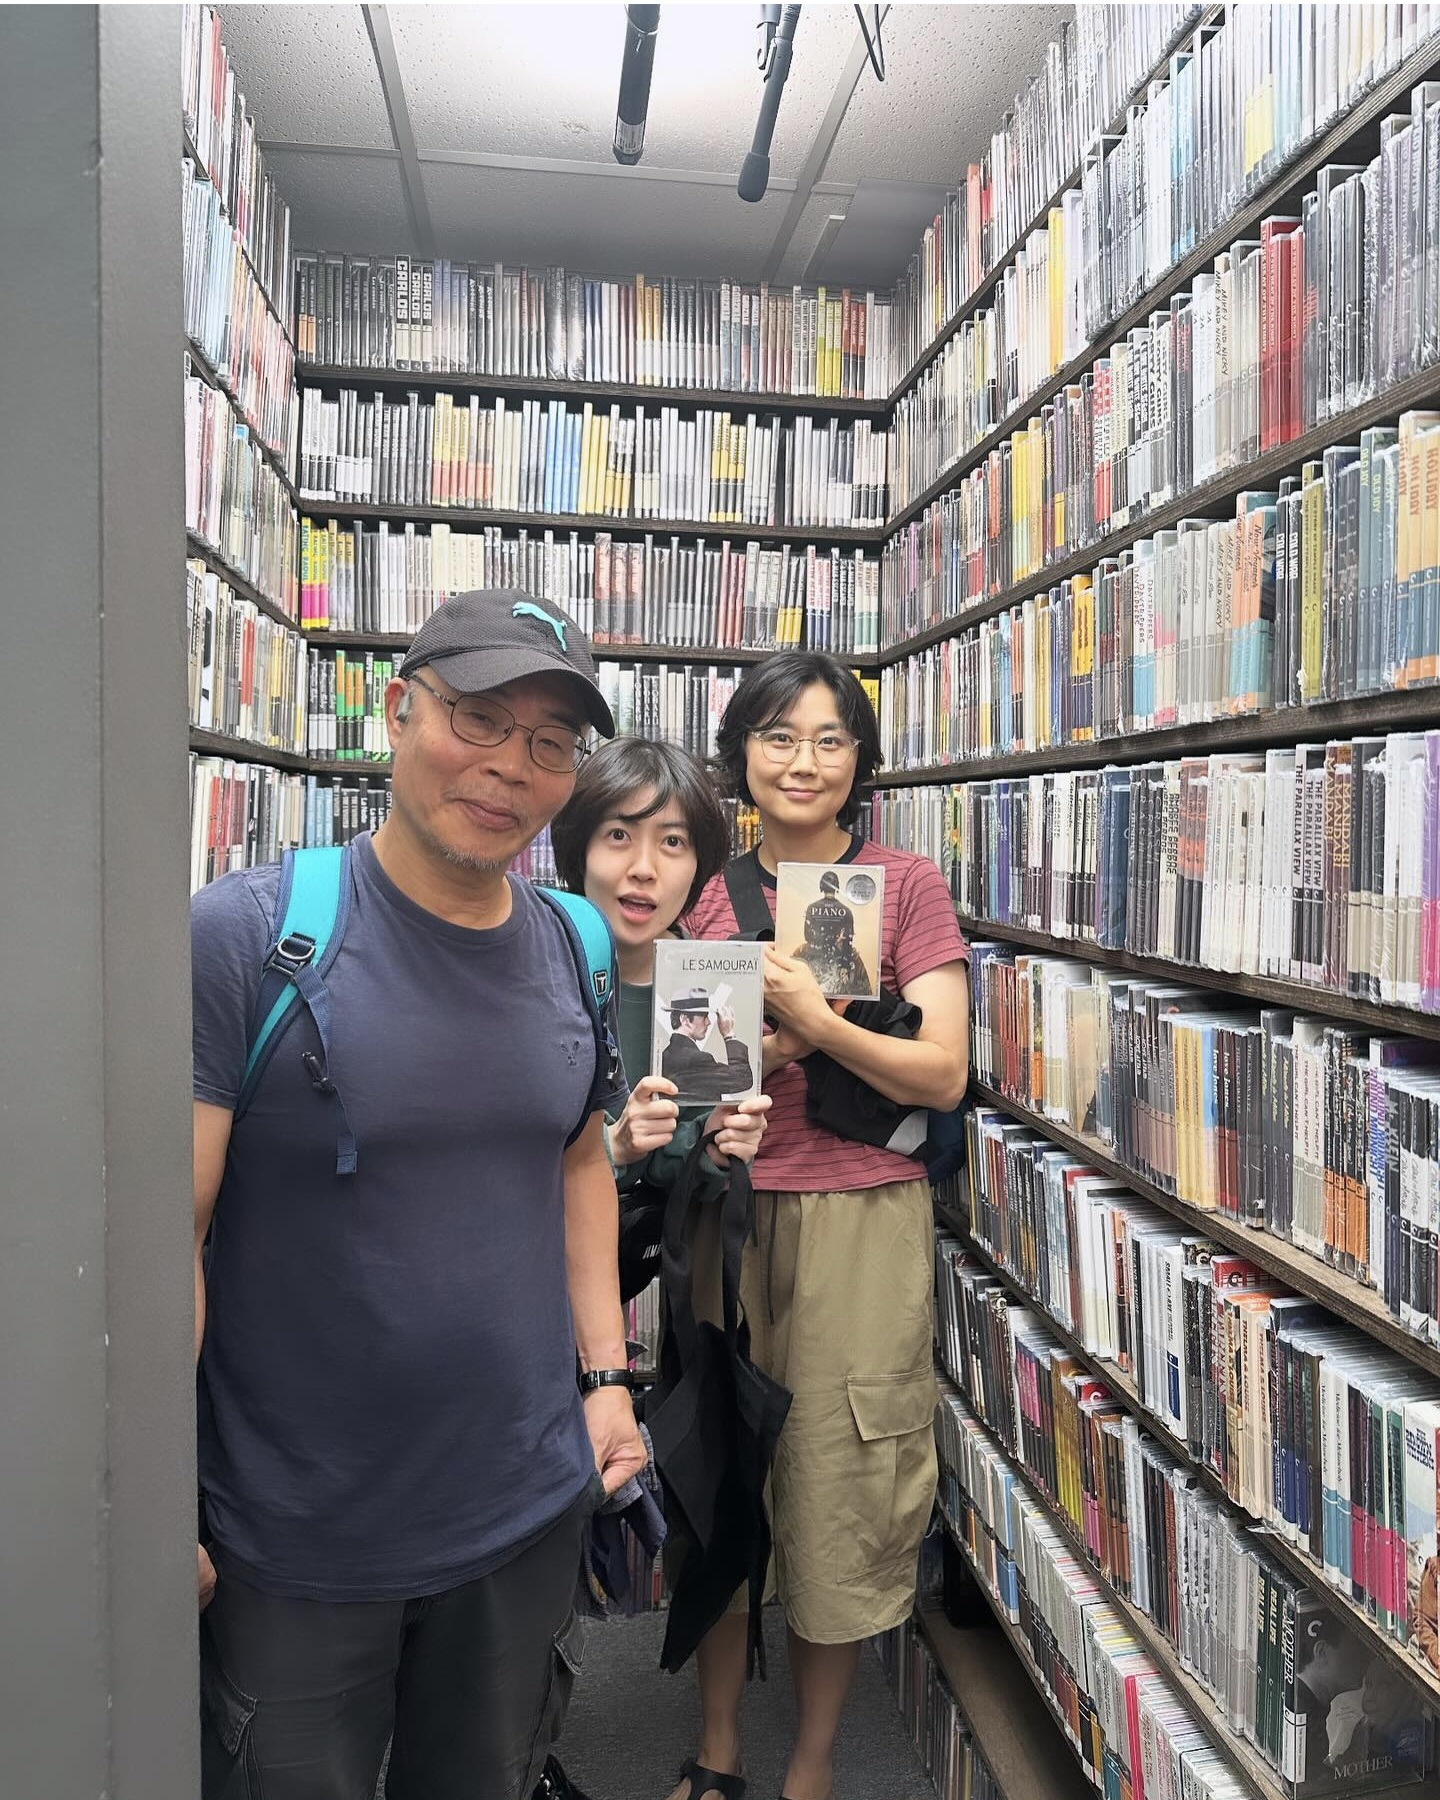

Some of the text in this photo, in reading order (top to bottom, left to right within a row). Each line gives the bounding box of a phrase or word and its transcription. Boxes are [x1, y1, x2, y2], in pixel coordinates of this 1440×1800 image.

[397, 260, 408, 319] CARLOS
[412, 272, 421, 319] CARLOS
[423, 273, 432, 319] CARLOS
[1361, 448, 1369, 486] OLD JOY
[1410, 455, 1420, 515] HOLIDAY
[1426, 448, 1438, 510] HOLIDAY
[1373, 497, 1381, 513] JOY
[1276, 533, 1285, 579] COLD WAR
[1289, 532, 1298, 579] COLD WAR
[1293, 765, 1303, 875] THE PARALLAX VIEW
[1304, 781, 1313, 884] THE PARALLAX VIEW
[1314, 781, 1322, 886] THE PARALLAX VIEW
[1333, 784, 1342, 867] MANDABI
[1342, 783, 1351, 868] MANDABI
[811, 908, 846, 916] PIANO
[682, 957, 758, 970] LE SAMOURAÏ
[1370, 1116, 1378, 1176] MIDNIGHT
[1390, 1128, 1399, 1172] KLEIN
[1284, 1617, 1294, 1684] MOTHER
[1334, 1755, 1393, 1779] MOTHER
